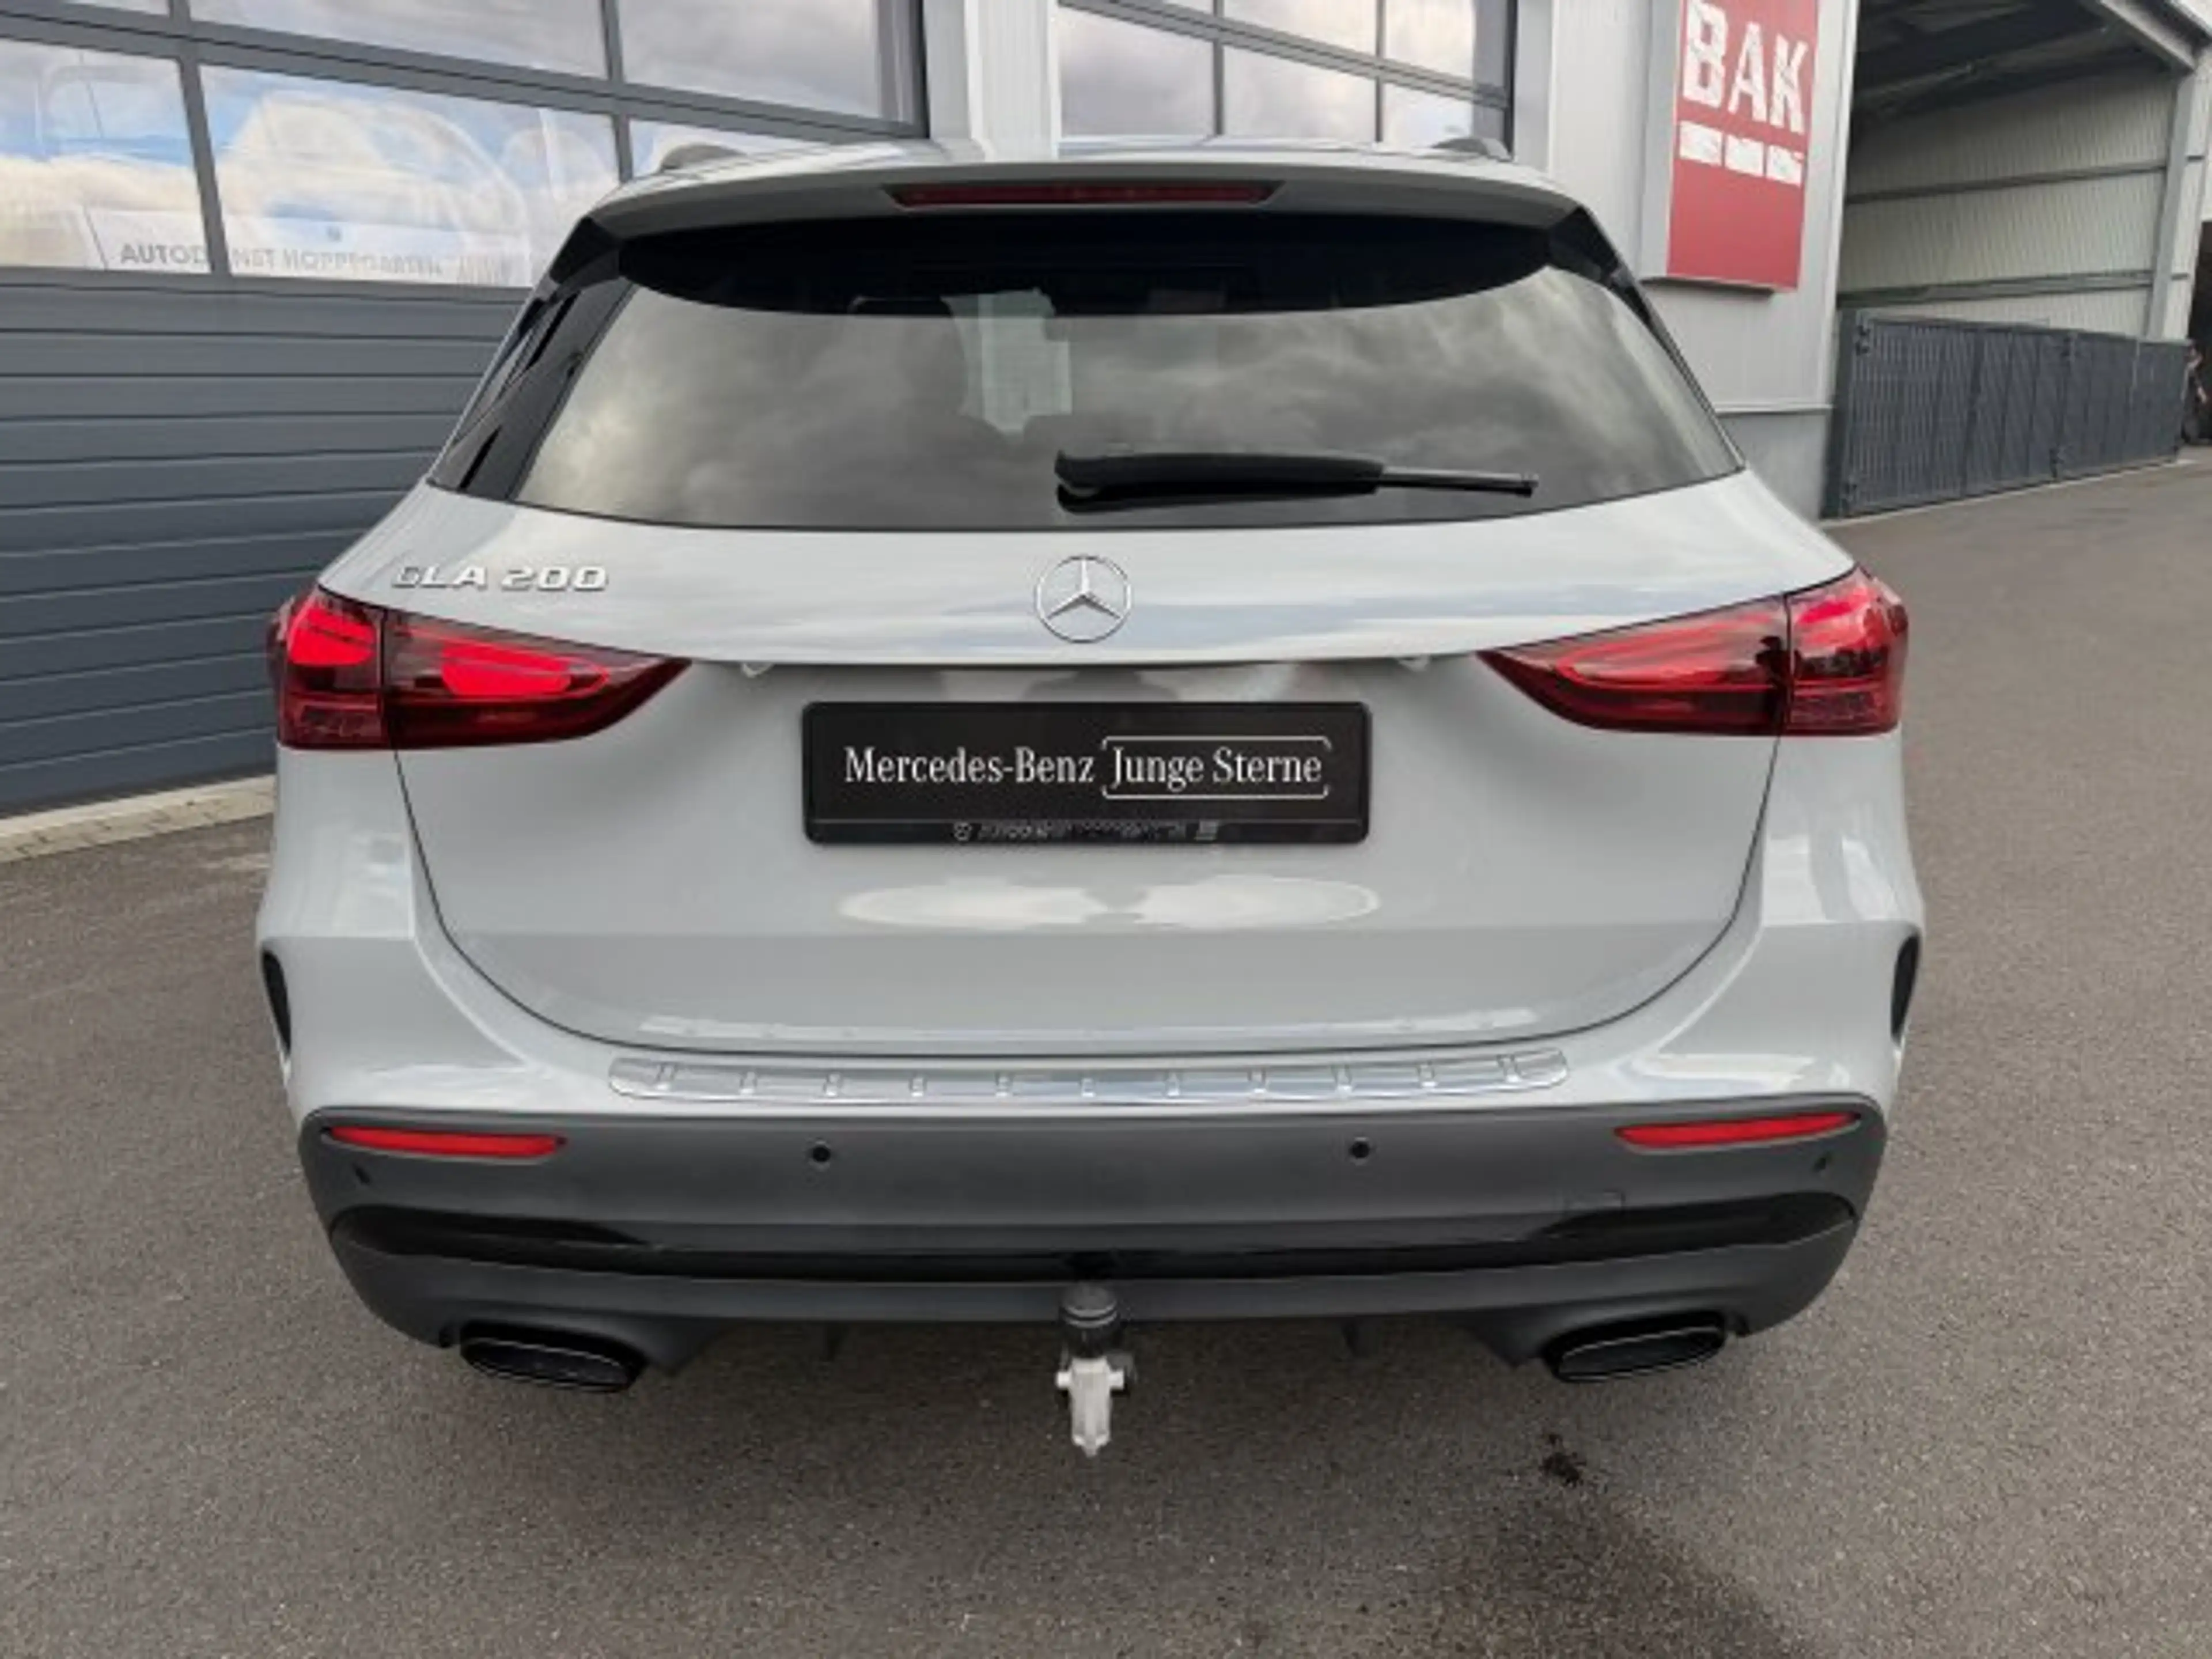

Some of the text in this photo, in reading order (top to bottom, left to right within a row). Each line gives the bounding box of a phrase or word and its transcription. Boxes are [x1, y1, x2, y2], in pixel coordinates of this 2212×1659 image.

[1682, 0, 1809, 135] BAK
[392, 565, 609, 592] GLA 200
[843, 746, 1323, 793] Mercedes-Benz Junge Sterne
